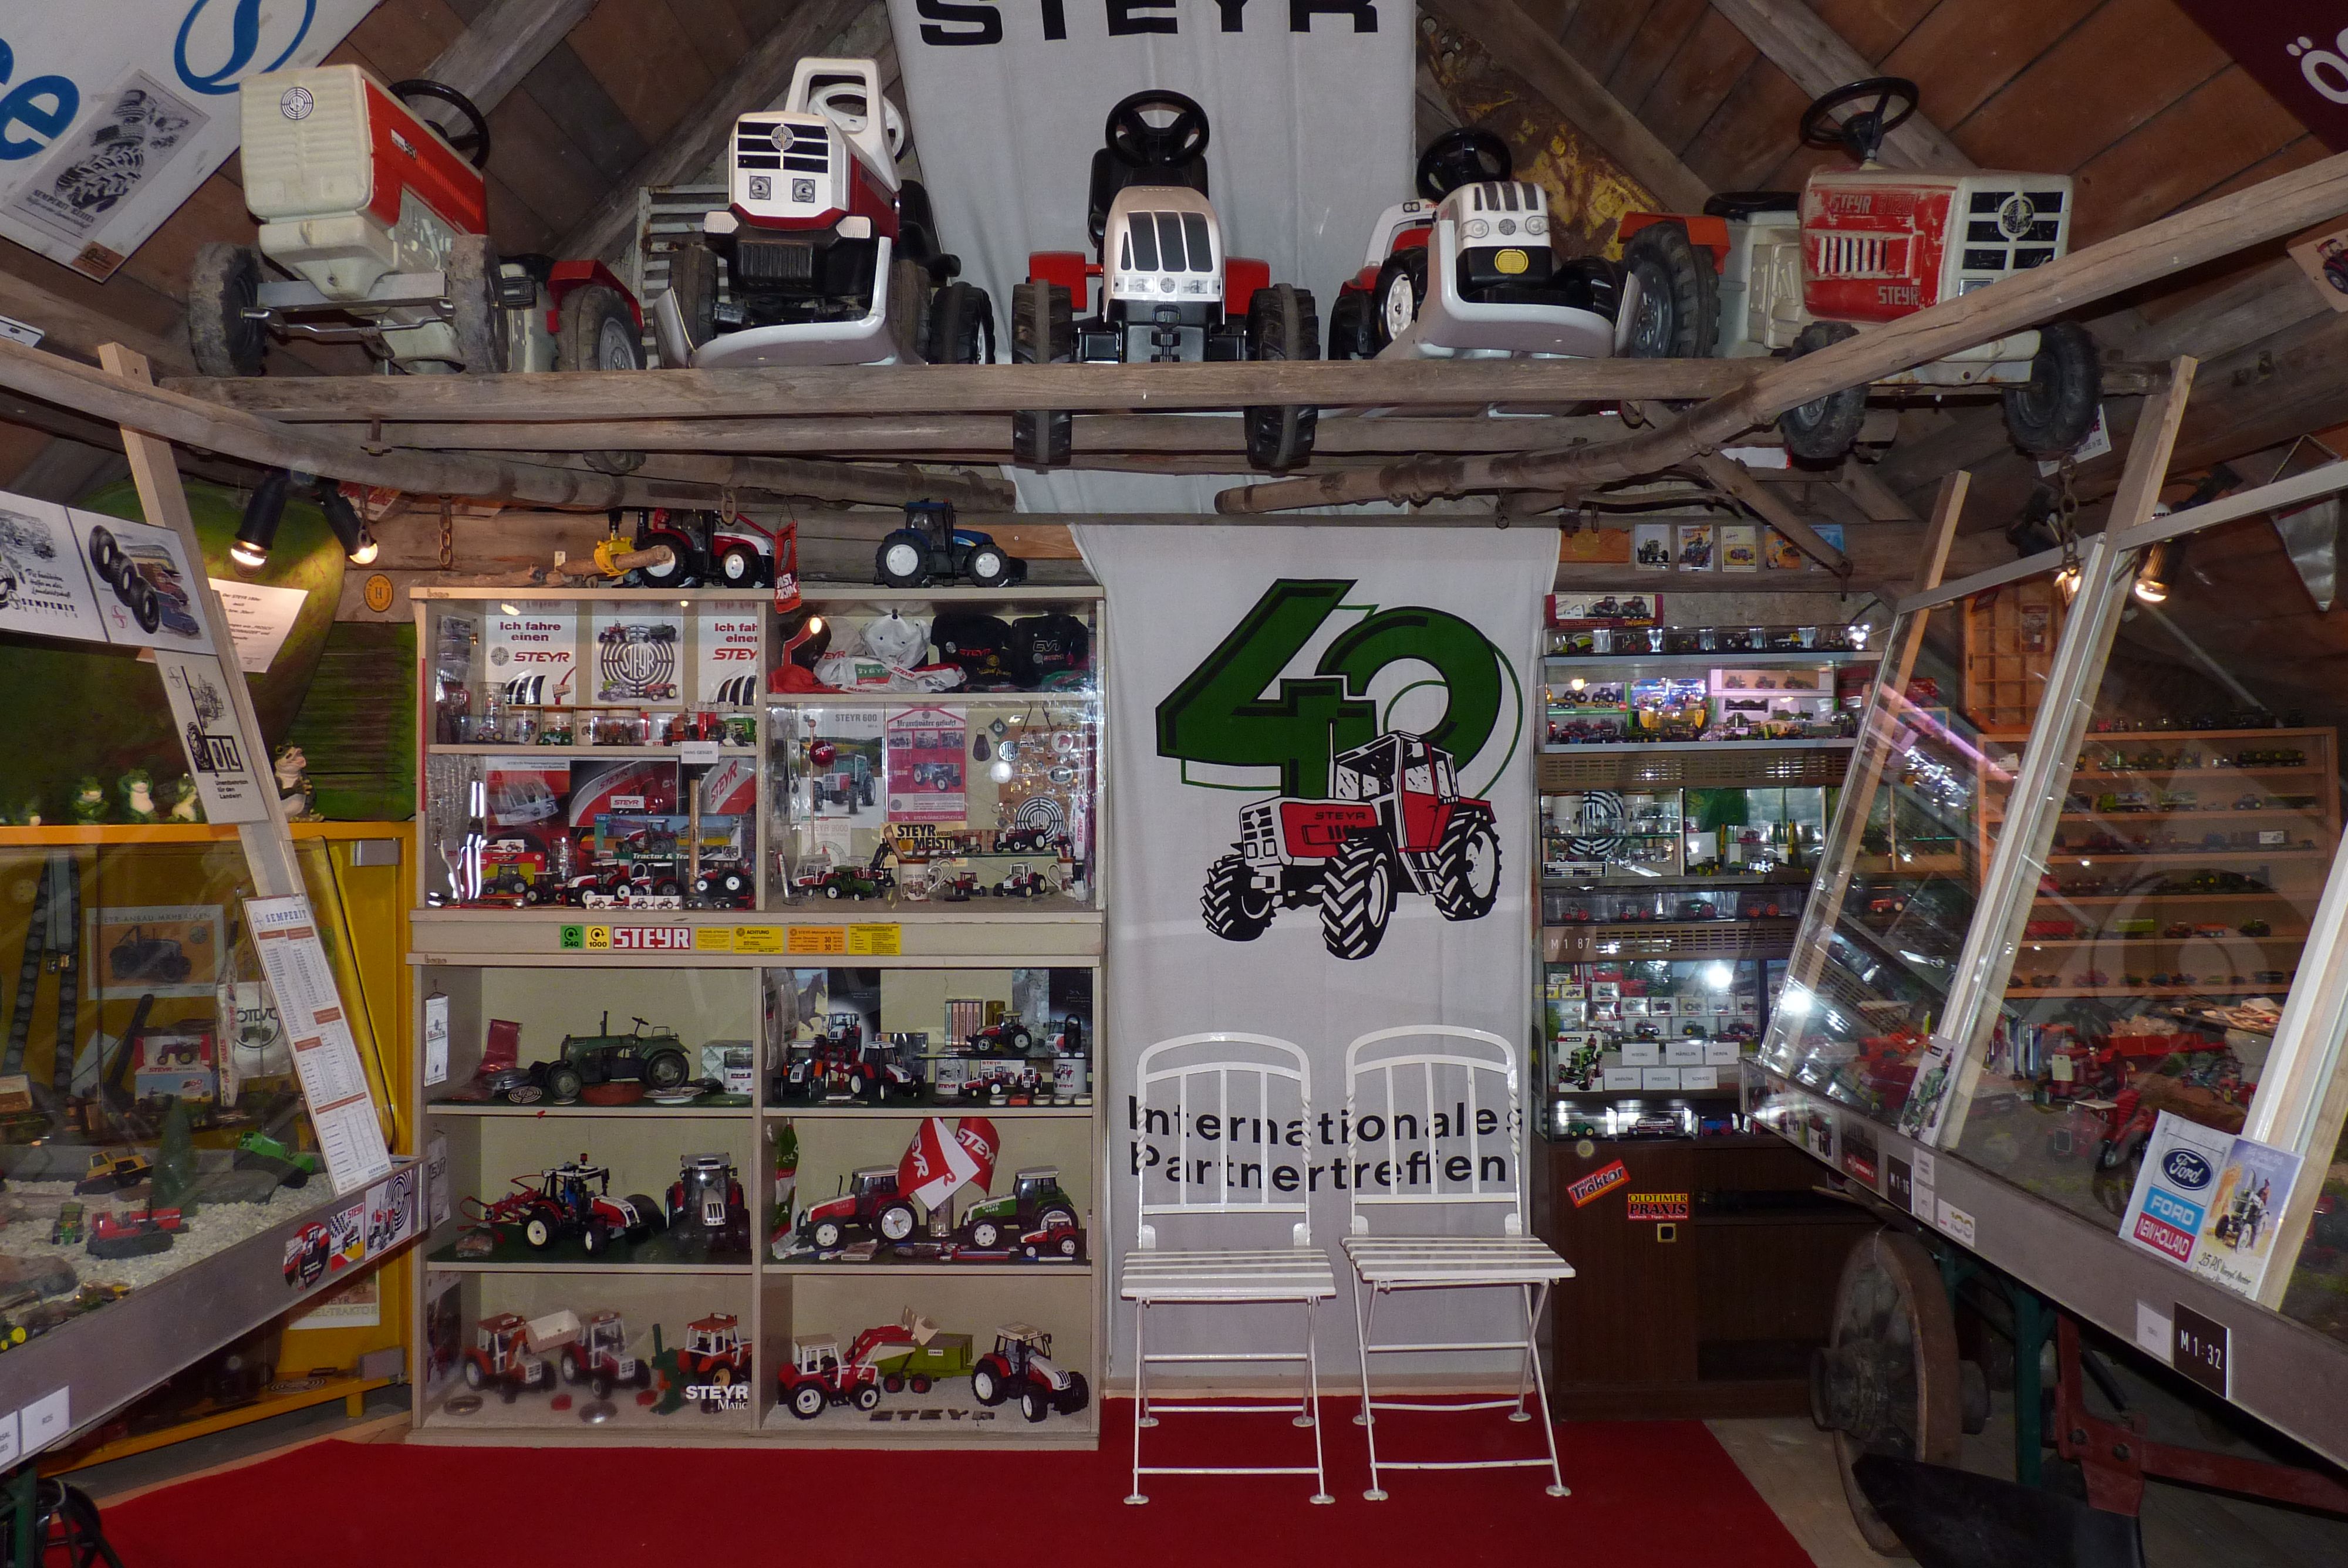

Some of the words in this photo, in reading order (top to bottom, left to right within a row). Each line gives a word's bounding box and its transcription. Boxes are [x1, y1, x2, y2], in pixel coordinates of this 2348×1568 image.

[1831, 194, 1871, 214] STEYR
[1878, 285, 1921, 306] STEYR
[21, 597, 75, 611] SEMPERIT
[500, 621, 521, 630] Ich
[525, 621, 562, 631] fahre
[714, 623, 734, 632] Ich
[511, 632, 549, 641] einen
[514, 652, 571, 663] STEYR
[959, 648, 993, 656] STEYR
[619, 643, 656, 679] STEYR
[892, 666, 916, 679] STEYR
[1155, 578, 1503, 798] 40
[835, 714, 861, 722] STEYR
[862, 714, 878, 722] 600
[598, 766, 630, 791] STEYR
[710, 760, 738, 806] STEYR
[1315, 812, 1366, 820] STEYR
[897, 824, 936, 837] STEYR
[265, 910, 307, 923] SEMPERIT
[614, 928, 690, 948] STEYR
[1550, 938, 1559, 949] M
[954, 1127, 997, 1165] STEYR
[2169, 1153, 2204, 1184] Ford
[1570, 1166, 1624, 1200] Traktor
[1628, 1194, 1687, 1202] OLDTIMER
[347, 1204, 363, 1219] STEYR
[1630, 1203, 1687, 1215] PRAXIS
[2150, 1194, 2195, 1225] FORD
[2138, 1218, 2157, 1239] NEW
[2154, 1225, 2190, 1256] HOLLAND
[2198, 1252, 2212, 1266] 25
[2209, 1256, 2222, 1272] PS
[2181, 1329, 2189, 1352] M
[2194, 1336, 2221, 1370] 1:32
[686, 1385, 748, 1400] STEYR
[868, 1409, 996, 1421] STEYR
